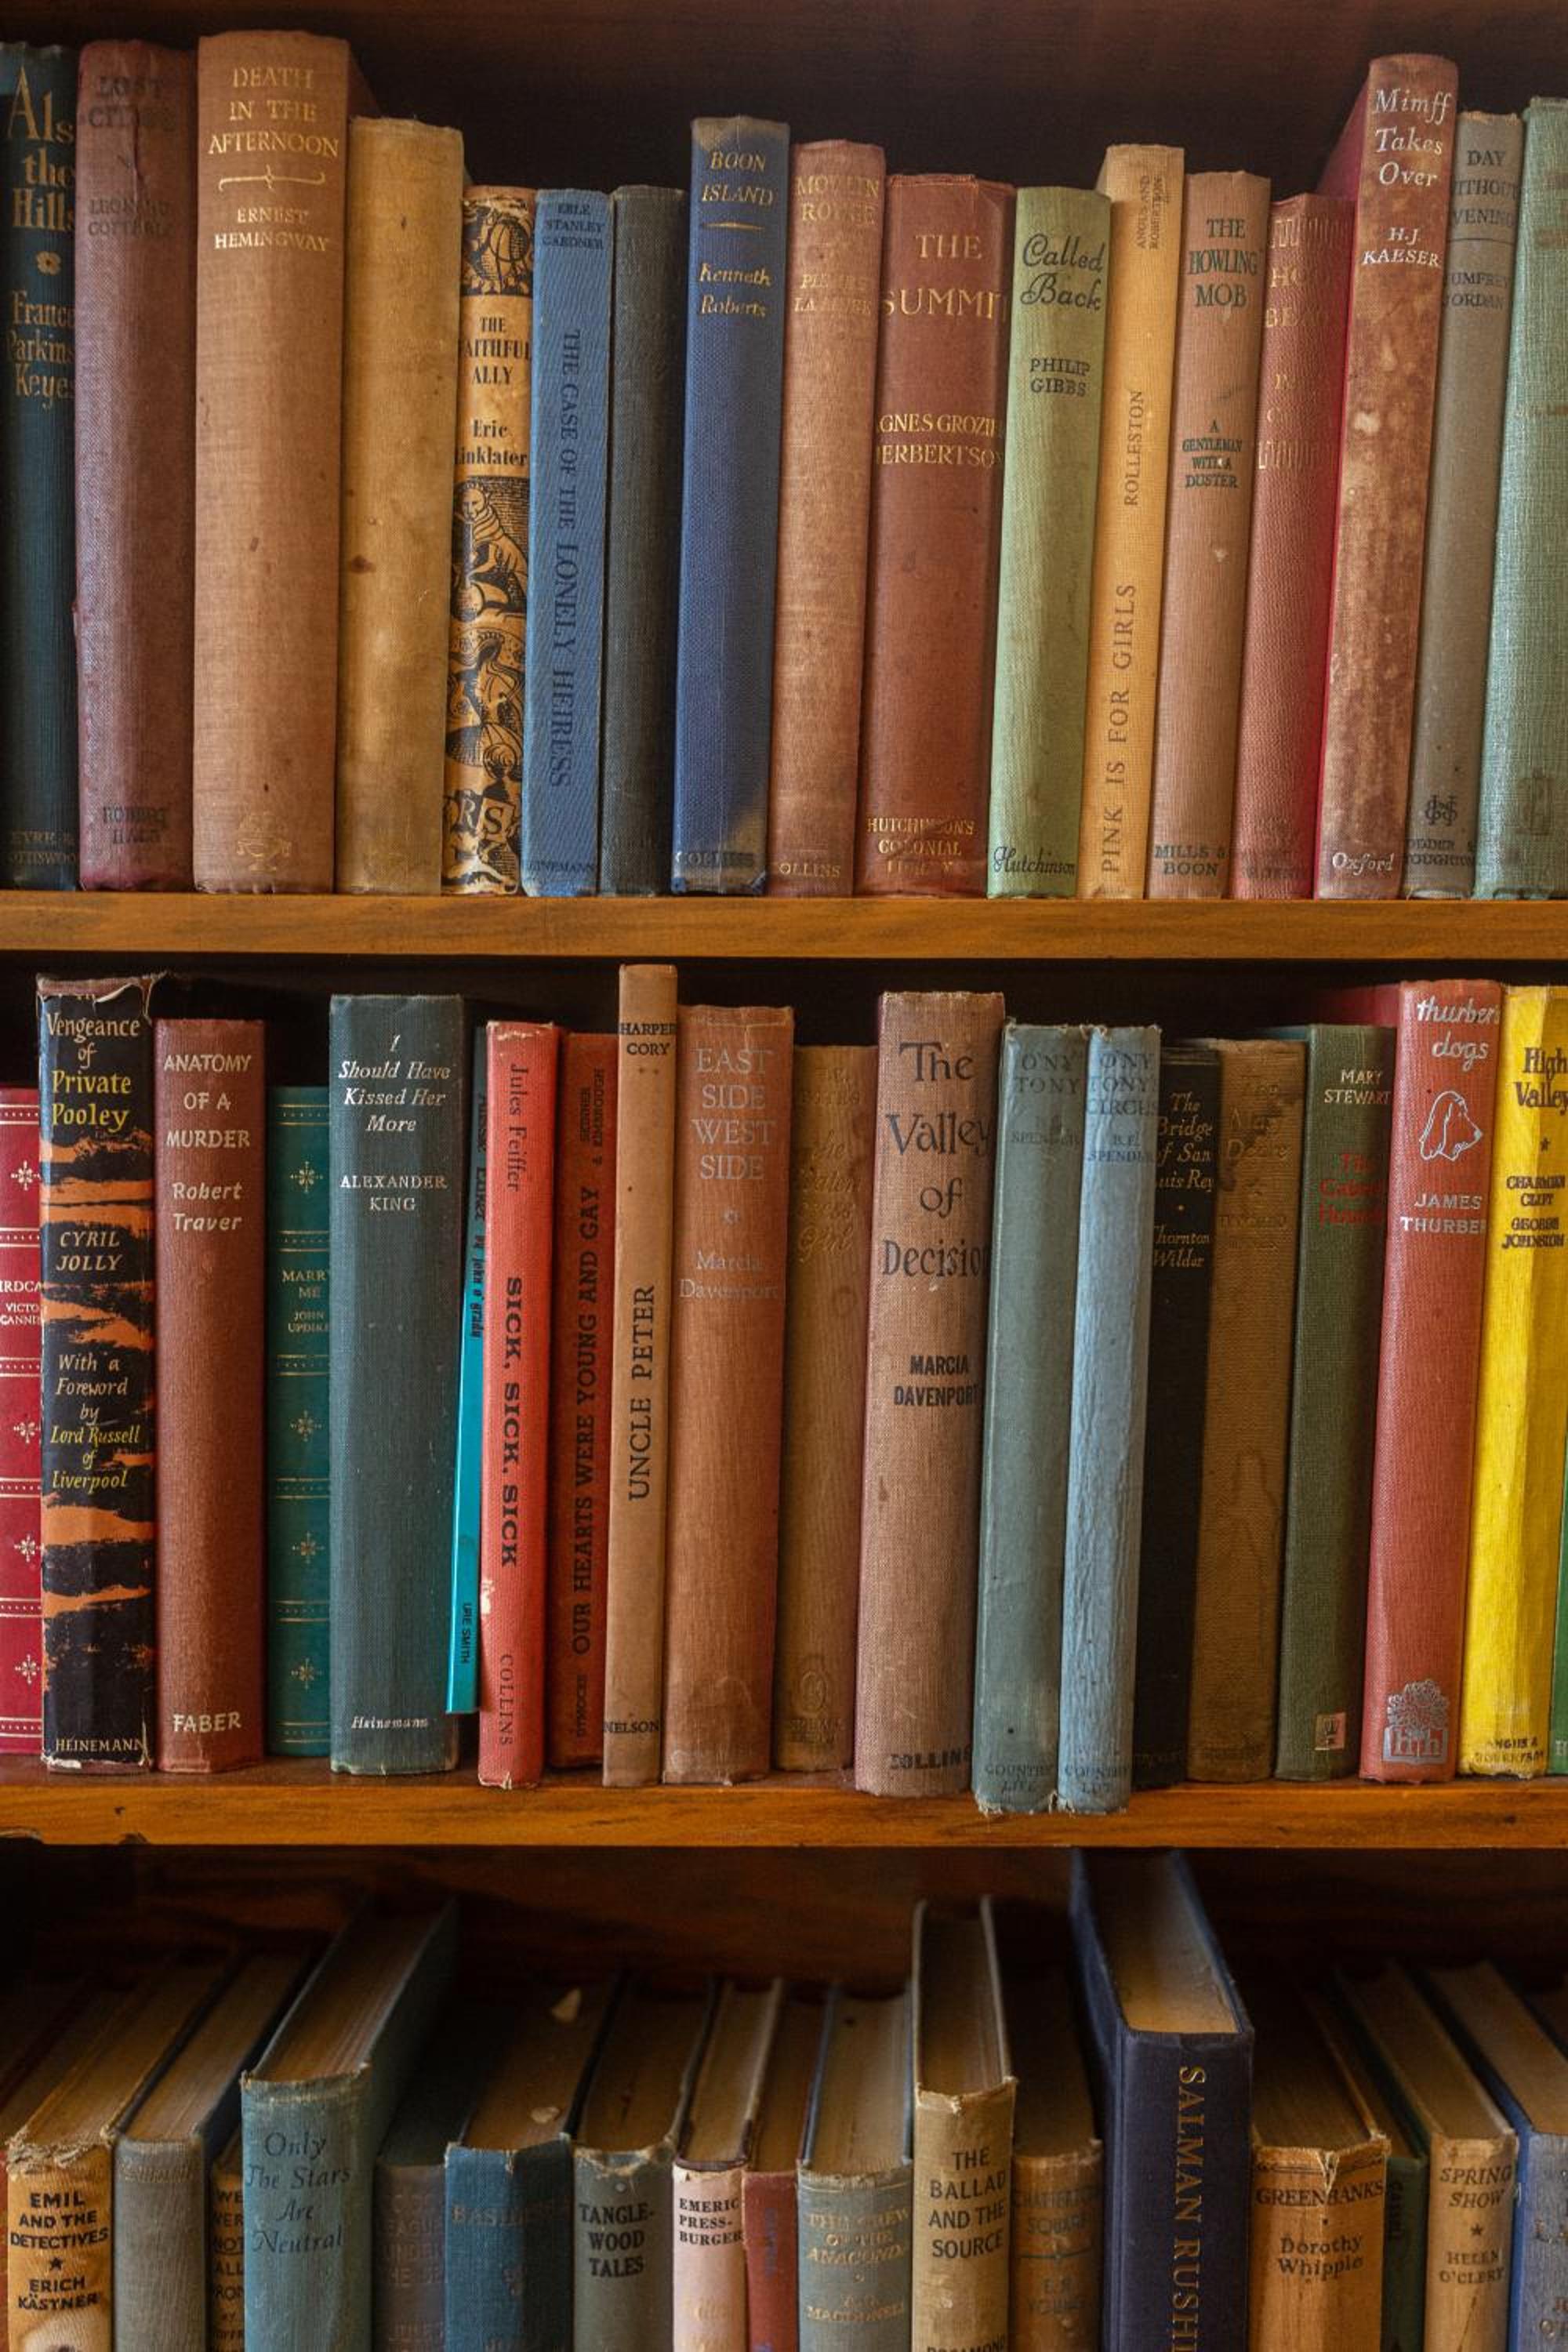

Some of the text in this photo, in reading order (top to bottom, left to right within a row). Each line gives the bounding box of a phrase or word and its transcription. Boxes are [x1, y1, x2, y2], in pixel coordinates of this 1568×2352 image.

[233, 67, 315, 89] DEATH
[229, 100, 316, 122] IN THE
[1372, 89, 1452, 126] Mimff
[209, 132, 339, 157] AFTERNOON
[1374, 127, 1443, 155] Takes
[711, 151, 766, 172] BOON
[1467, 150, 1506, 167] DAY
[1379, 161, 1438, 187] Over
[702, 183, 774, 205] ISLAND
[236, 208, 309, 224] ERNEST
[1207, 219, 1246, 239] THE
[215, 232, 328, 252] HEMINGWAY
[543, 237, 604, 250] GARDNER
[916, 234, 983, 260] THE
[1022, 234, 1104, 272] Called
[1188, 249, 1258, 277] HOWLING
[1362, 249, 1442, 268] KAESER
[699, 263, 771, 287] Kenneth
[1020, 272, 1101, 312] Back
[1195, 283, 1247, 307] MOB
[701, 294, 766, 318] Roberts
[479, 317, 507, 334] THE
[471, 366, 513, 385] ALLY
[1029, 358, 1091, 377] PHILIP
[1030, 378, 1087, 397] GIBBS
[473, 419, 508, 439] Eric
[877, 414, 933, 433] GNES
[1210, 419, 1219, 433] A
[1123, 390, 1145, 506] ROLLESTON
[1181, 437, 1243, 452] GENTLEMAN
[1185, 474, 1240, 489] DUSTER
[549, 329, 580, 786] THE CASE OF THE LONELY HEIRESS
[1112, 583, 1137, 670] GIRLS
[1108, 689, 1131, 743] FOR
[1106, 761, 1126, 785] IS
[1102, 805, 1123, 873] PINK
[993, 845, 1077, 877] Hutchinson
[1155, 844, 1209, 858] MILLS
[1163, 862, 1218, 877] BOON
[1331, 851, 1396, 877] Oxford
[46, 1012, 140, 1044] Vengeance
[77, 1042, 97, 1070] of
[626, 1043, 670, 1056] CORY
[1432, 1032, 1490, 1073] dogs
[164, 1054, 252, 1073] ANATOMY
[338, 1061, 452, 1080] Should Have
[695, 1049, 772, 1074] EAST
[898, 1041, 975, 1082] The
[52, 1069, 132, 1094] Private
[1015, 1077, 1080, 1095] TONY
[1340, 1069, 1382, 1084] MARY
[183, 1092, 231, 1111] OF A
[344, 1087, 446, 1106] Kissed Her
[702, 1084, 766, 1109] SIDE
[1171, 1091, 1200, 1113] The
[1323, 1089, 1392, 1105] STEWART
[52, 1102, 130, 1133] Pooley
[365, 1115, 417, 1132] More
[507, 1063, 528, 1192] Jules Feiffer
[165, 1130, 251, 1149] MURDER
[691, 1119, 776, 1145] WEST
[1177, 1142, 1212, 1162] San
[700, 1154, 764, 1181] SIDE
[172, 1181, 243, 1200] Robert
[340, 1175, 448, 1189] ALEXANDER
[1186, 1171, 1214, 1193] Rey
[369, 1197, 416, 1212] KING
[920, 1178, 963, 1218] of
[1414, 1193, 1483, 1210] JAMES
[172, 1213, 242, 1232] Traver
[579, 1186, 600, 1240] GAY
[60, 1231, 120, 1248] CYRIL
[56, 1254, 121, 1272] JOLLY
[577, 1250, 599, 1303] AND
[293, 1310, 325, 1322] JOHN
[58, 1352, 121, 1373] With a
[577, 1313, 597, 1405] YOUNG
[910, 1354, 969, 1376] MARCIA
[55, 1377, 129, 1397] Foreword
[629, 1284, 655, 1501] UNCLE PETER
[79, 1403, 100, 1426] by
[501, 1277, 522, 1569] SICK, SICK, SICK
[50, 1424, 140, 1447] Lord Russell
[82, 1450, 97, 1471] of
[575, 1415, 596, 1487] WERE
[52, 1469, 128, 1494] Liverpool
[572, 1496, 593, 1593] HEARTS
[572, 1602, 591, 1656] OUR
[499, 1653, 515, 1746] COLLINS
[172, 1711, 242, 1733] FABER
[350, 1715, 429, 1730] Heinemann
[602, 1720, 661, 1733] NELSON
[55, 1737, 143, 1753] HEINEMANN
[264, 2132, 326, 2160] Only
[1173, 2064, 1207, 2223] SALMAN
[951, 2147, 989, 2171] THE
[245, 2163, 351, 2190] The Stars
[930, 2170, 1005, 2200] BALLAD
[1439, 2165, 1512, 2186] SPRING
[29, 2190, 86, 2209] EMIL
[276, 2198, 314, 2222] Are
[679, 2197, 740, 2213] EMERIC
[1449, 2190, 1504, 2209] SHOW
[19, 2209, 98, 2229] AND THE
[579, 2201, 655, 2226] TANGLE-
[678, 2214, 733, 2229] PRESS-
[927, 2209, 971, 2230] AND
[975, 2200, 1004, 2225] THE
[9, 2227, 110, 2250] DETECTIVES
[251, 2225, 343, 2255] Neutral
[588, 2230, 644, 2252] WOOD
[931, 2227, 1004, 2259] SOURCE
[1280, 2233, 1363, 2256] Dorothy
[589, 2256, 644, 2278] TALES
[1279, 2256, 1364, 2282] Whipple
[1446, 2250, 1499, 2266] HELEN
[28, 2275, 85, 2293] ERICH
[17, 2292, 101, 2311] KÄSTNER
